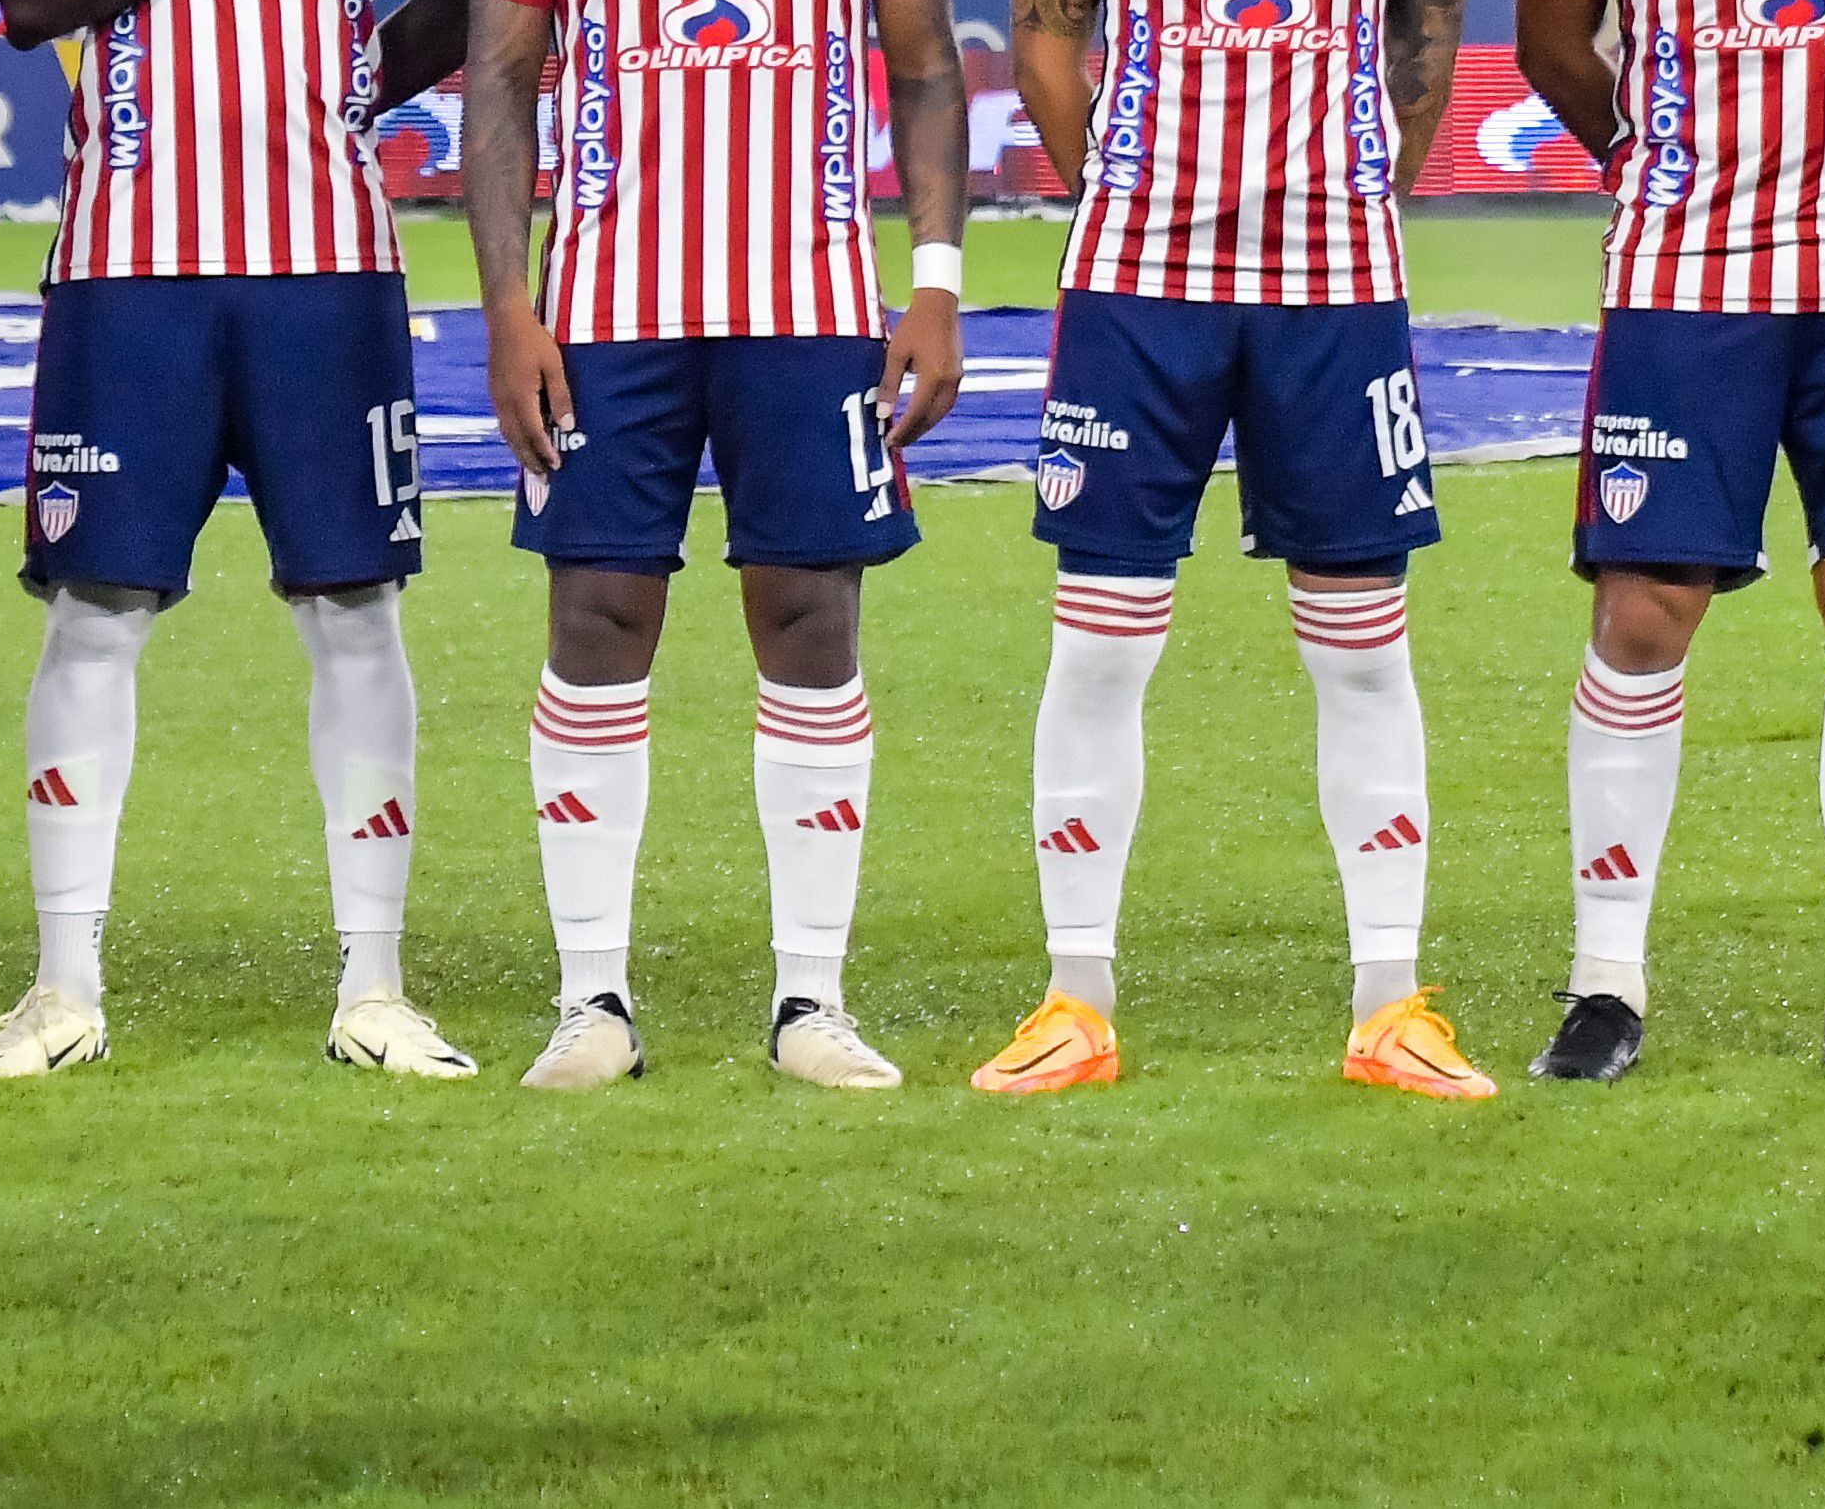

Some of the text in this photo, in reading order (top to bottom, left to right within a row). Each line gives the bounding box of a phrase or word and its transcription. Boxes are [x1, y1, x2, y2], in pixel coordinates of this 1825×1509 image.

[1160, 23, 1349, 52] OLIMPICA
[618, 44, 815, 72] OLIMPICA
[1366, 369, 1426, 477] 18
[367, 399, 421, 507] 15
[1592, 428, 1688, 460] brasilia
